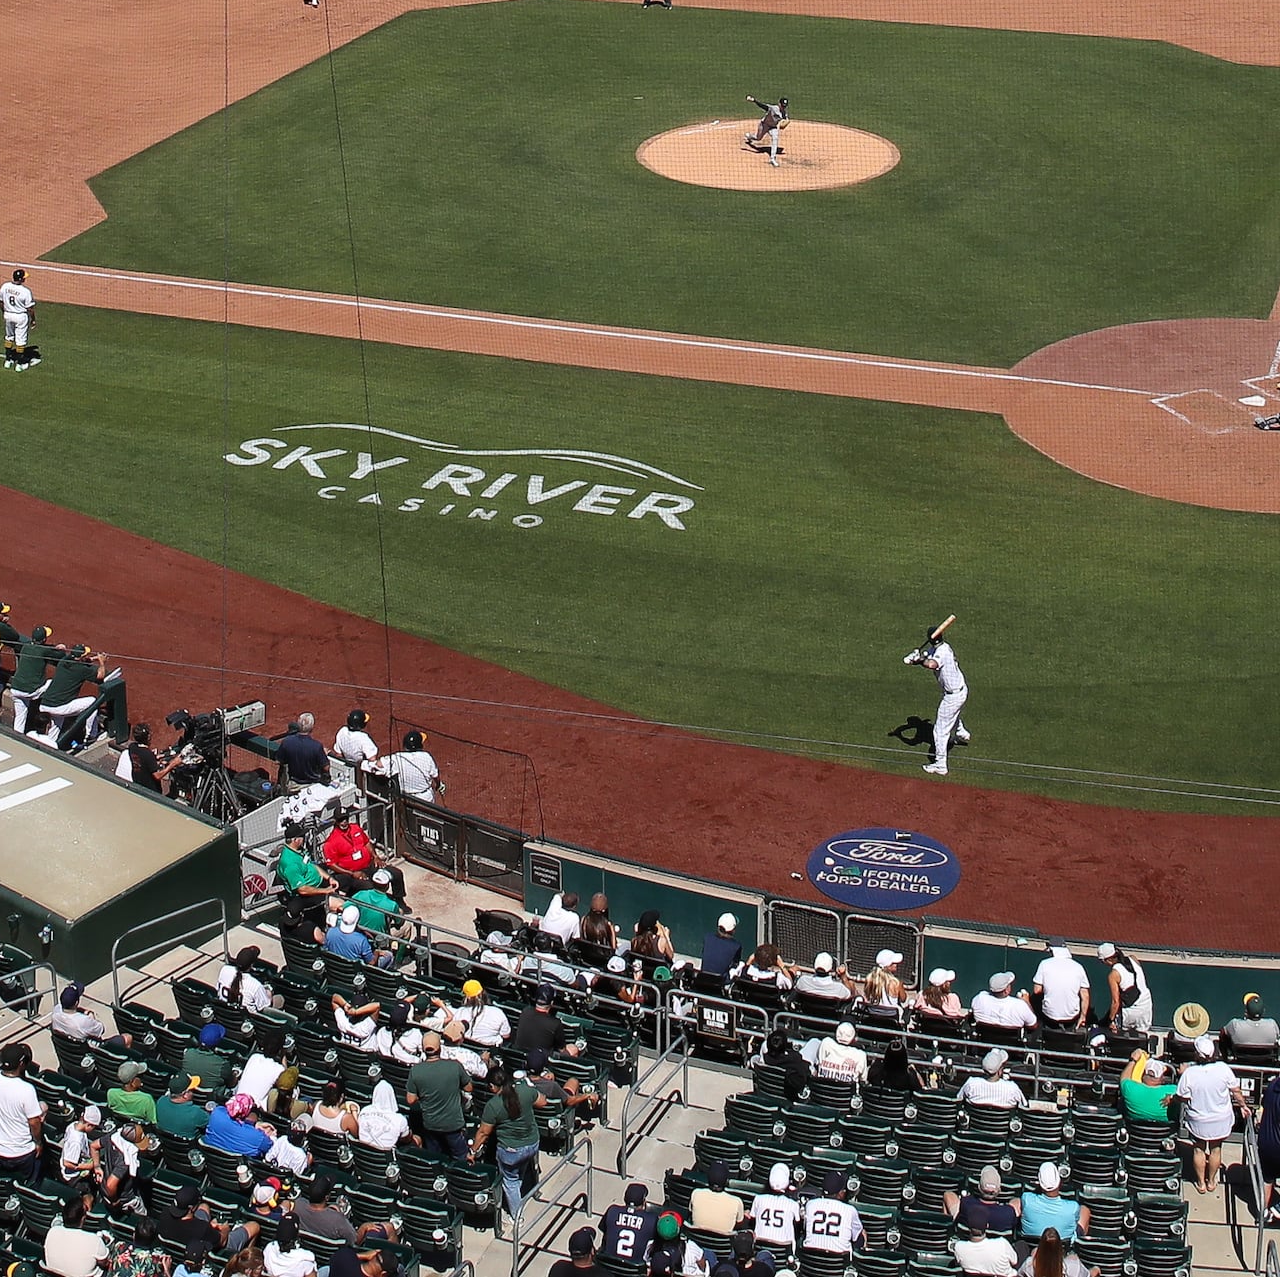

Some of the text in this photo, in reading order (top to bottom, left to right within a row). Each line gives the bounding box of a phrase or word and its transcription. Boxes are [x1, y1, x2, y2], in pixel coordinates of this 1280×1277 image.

[223, 438, 696, 531] SKY RIVER
[317, 486, 544, 529] CASINO
[849, 842, 925, 865] Ford
[816, 871, 941, 895] FORD DEALERS
[615, 1213, 644, 1230] JETER
[760, 1208, 784, 1228] 45
[813, 1210, 841, 1237] 22
[616, 1230, 636, 1258] 2
